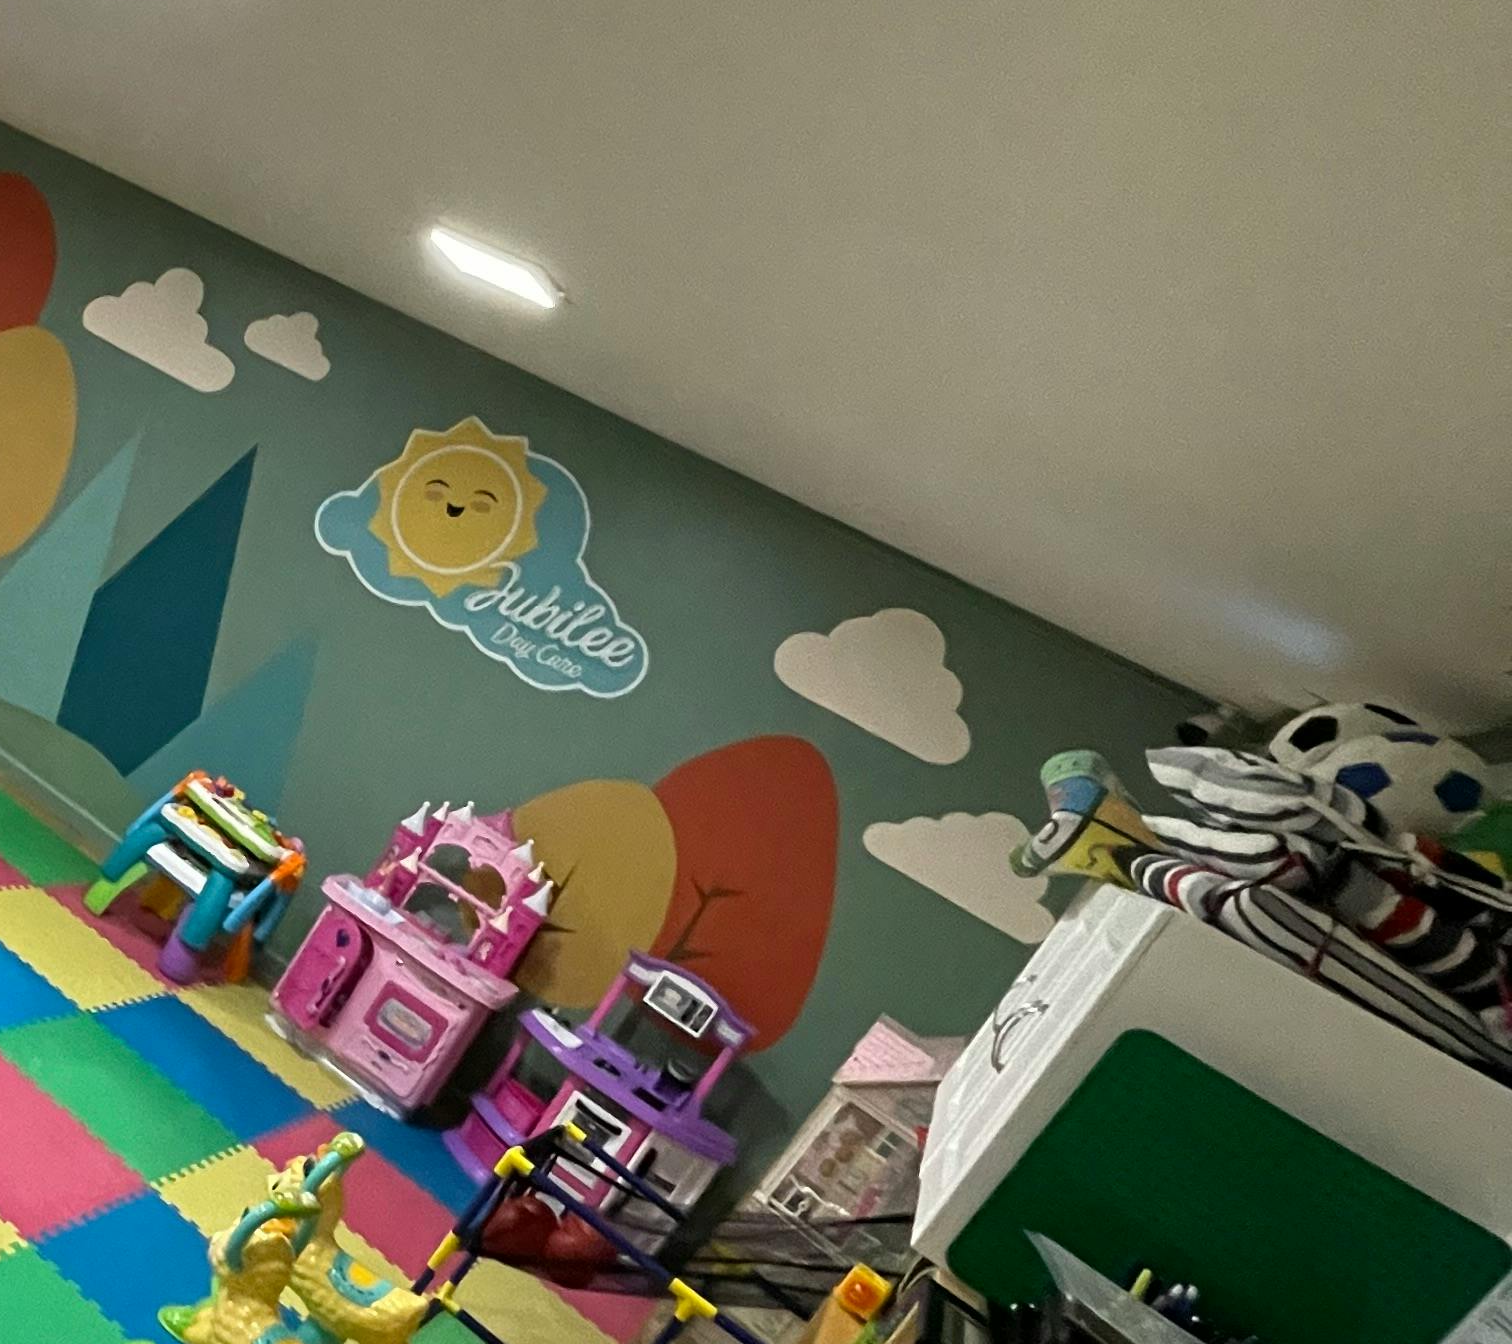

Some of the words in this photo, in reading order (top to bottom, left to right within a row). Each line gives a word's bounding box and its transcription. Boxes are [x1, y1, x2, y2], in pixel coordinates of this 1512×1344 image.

[465, 561, 635, 667] Jubilee
[491, 622, 536, 660] Day
[536, 645, 582, 678] Care
